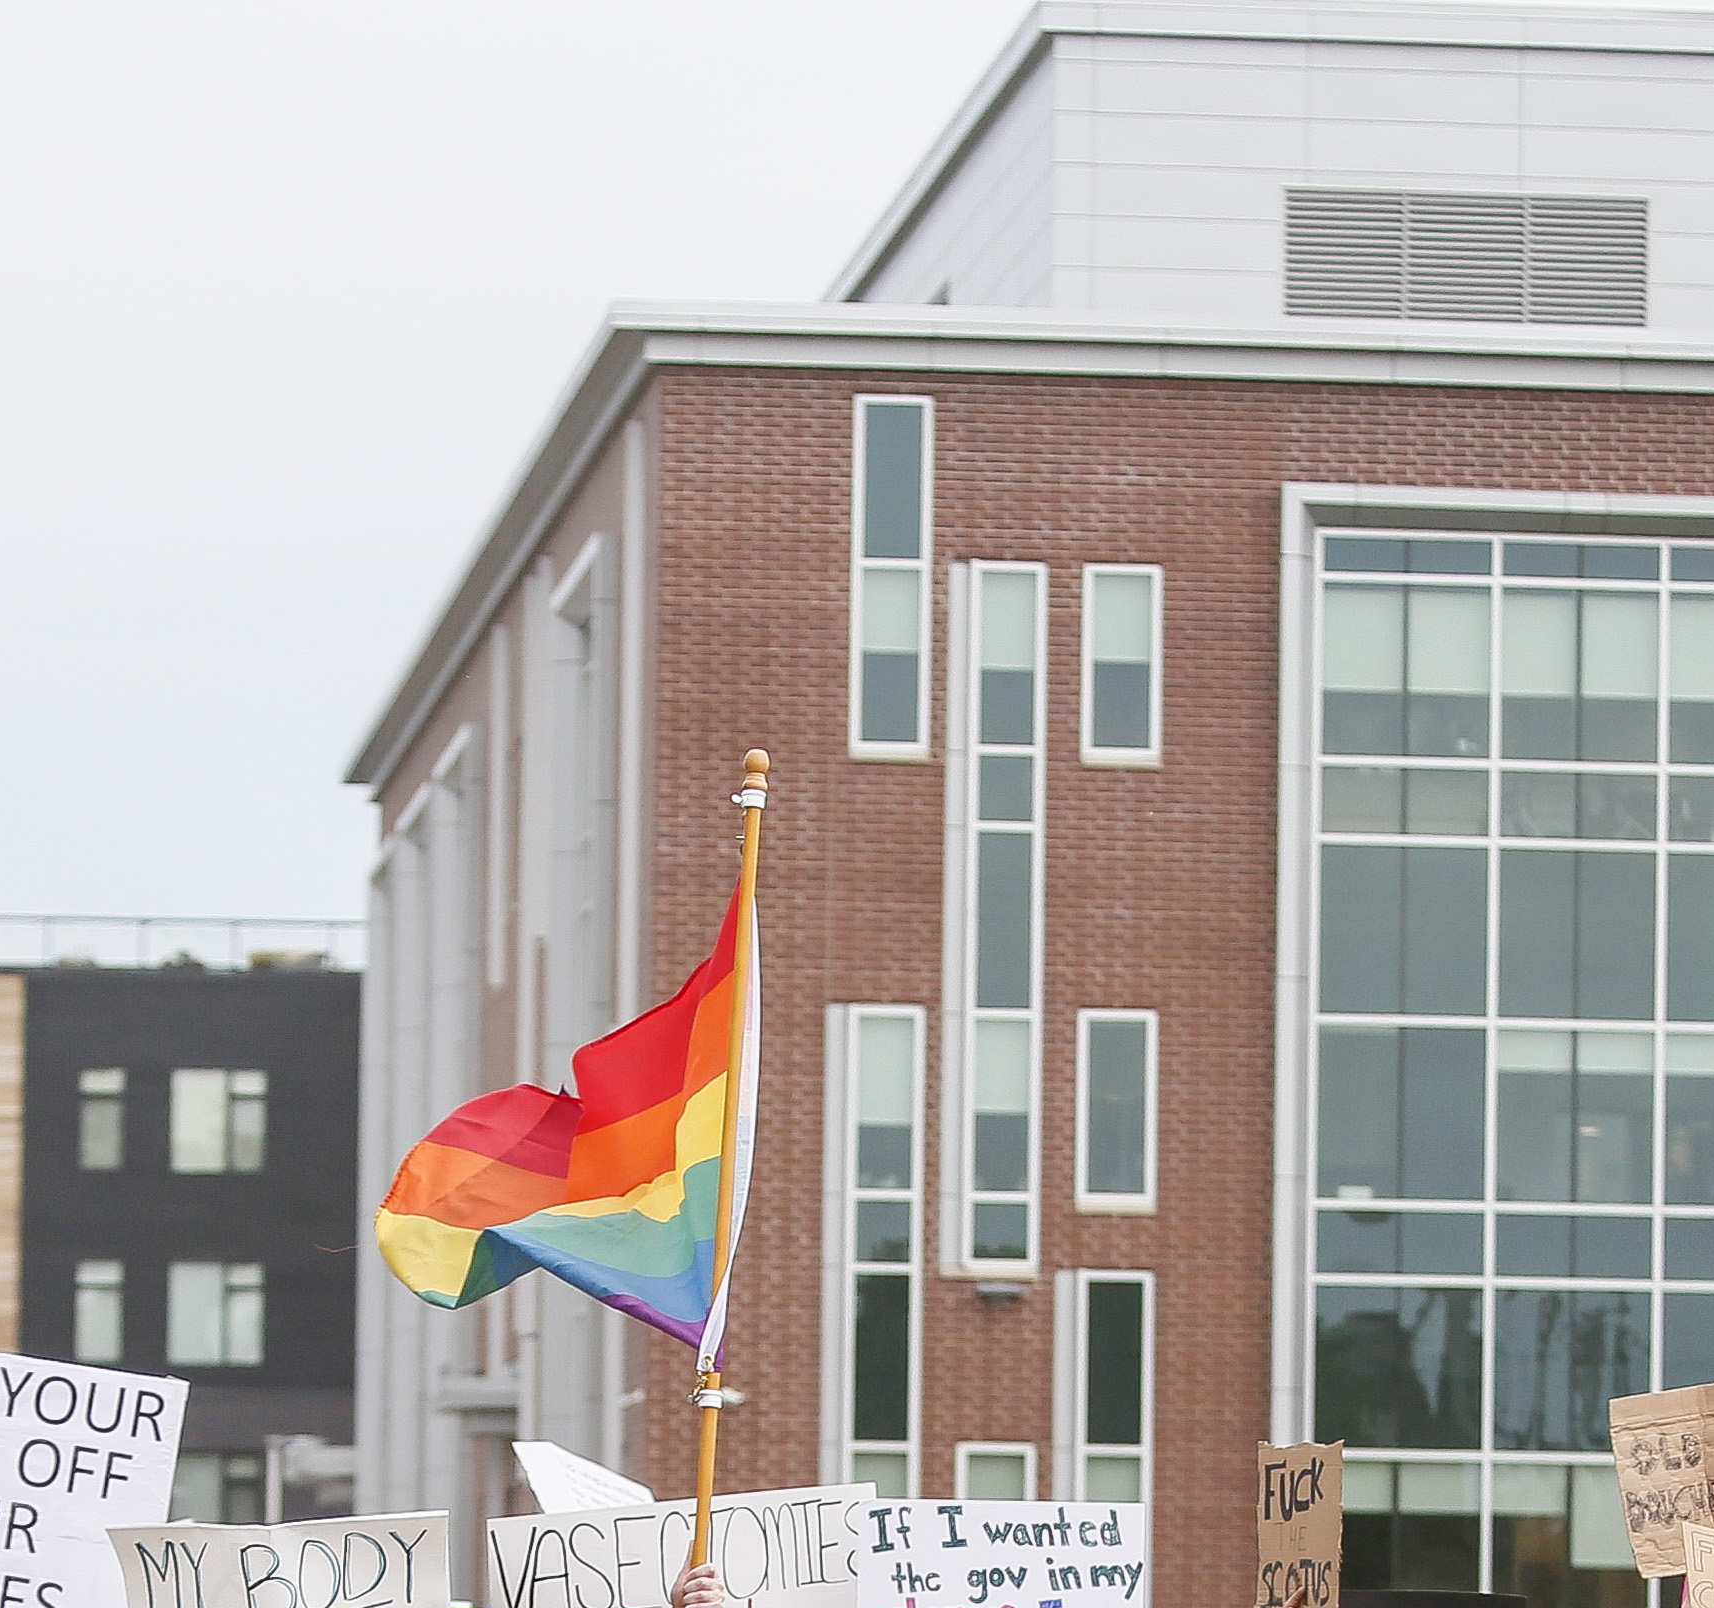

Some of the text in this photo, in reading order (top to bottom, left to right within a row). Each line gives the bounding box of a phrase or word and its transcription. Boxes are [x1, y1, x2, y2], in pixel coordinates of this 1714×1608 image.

[0, 1366, 166, 1443] YOUR
[16, 1437, 132, 1500] OFF
[1263, 1457, 1325, 1522] FUCK
[869, 1505, 1122, 1553] If I wanted
[892, 1557, 1143, 1603] the gov in my
